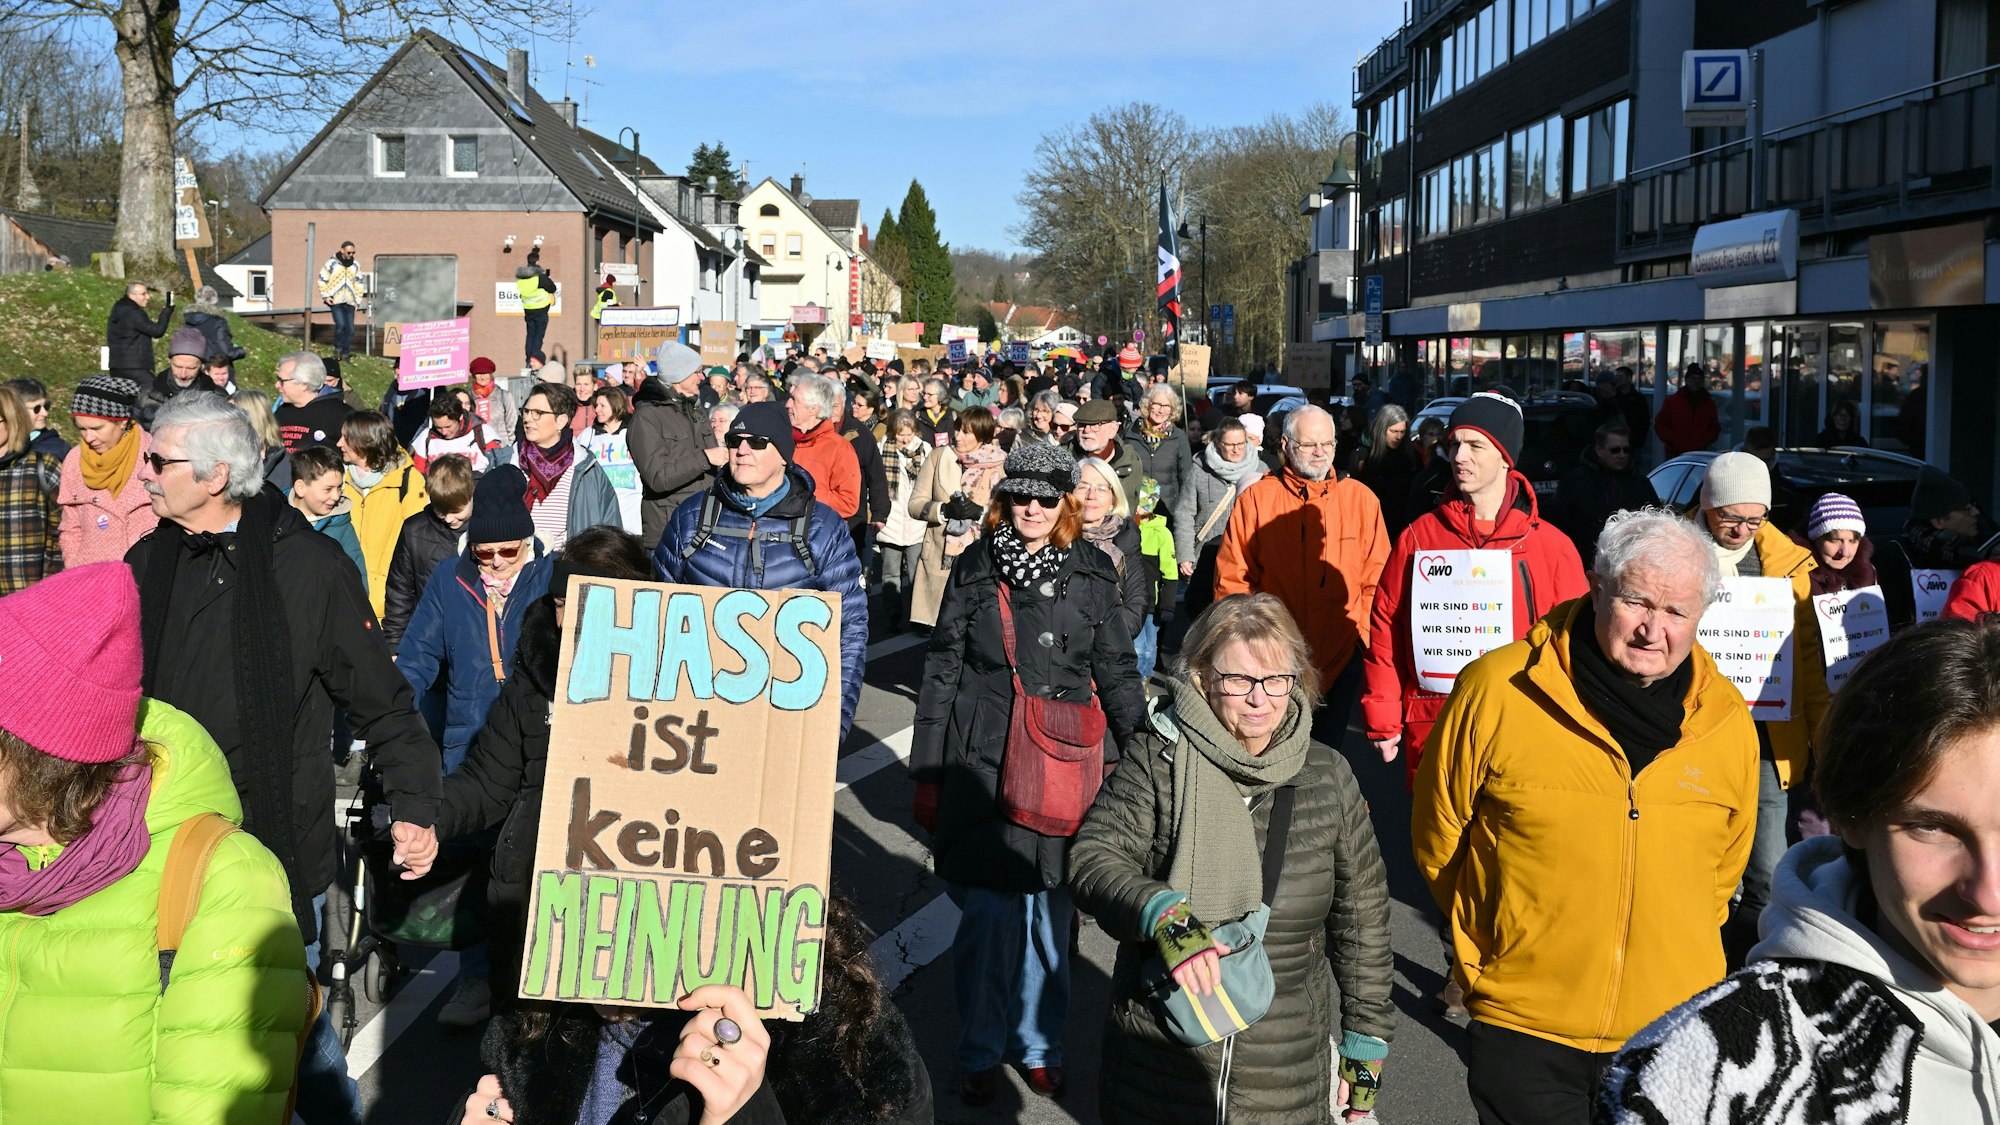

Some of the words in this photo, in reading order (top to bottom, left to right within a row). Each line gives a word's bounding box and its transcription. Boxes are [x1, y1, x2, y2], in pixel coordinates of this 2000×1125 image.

[1695, 249, 1734, 273] Deutsche
[1736, 245, 1760, 267] Bank
[1367, 279, 1374, 295] P
[1213, 306, 1219, 317] P
[950, 342, 964, 351] FCK
[1012, 345, 1026, 353] FCK
[951, 351, 966, 359] NZS
[1012, 353, 1027, 361] AFD
[1427, 565, 1453, 577] AWO
[1926, 581, 1948, 591] AWO
[1714, 591, 1732, 603] WO
[1420, 602, 1440, 611] WIR
[1443, 602, 1469, 611] SIND
[1472, 603, 1503, 611] BUNT
[1829, 604, 1847, 615] AWO
[1422, 625, 1442, 634] WIR
[1445, 625, 1471, 634] SIND
[1474, 626, 1501, 634] HIER
[1699, 629, 1720, 637] WIR
[1723, 629, 1750, 638] SIND
[1753, 630, 1784, 638] BUNT
[1829, 636, 1843, 644] WIR
[1845, 632, 1862, 641] SIND
[1863, 628, 1884, 637] BUNT
[567, 583, 833, 711] HASS
[1423, 648, 1443, 656] WIR
[1446, 648, 1472, 656] SIND
[1707, 652, 1722, 660] IR
[1725, 652, 1752, 661] SIND
[1755, 653, 1782, 661] HIER
[1833, 655, 1847, 663] WIR
[1848, 651, 1866, 660] SIND
[1759, 675, 1781, 684] FÜR
[627, 705, 720, 775] ist
[565, 777, 781, 878] keine
[522, 870, 827, 1013] MEINUNG
